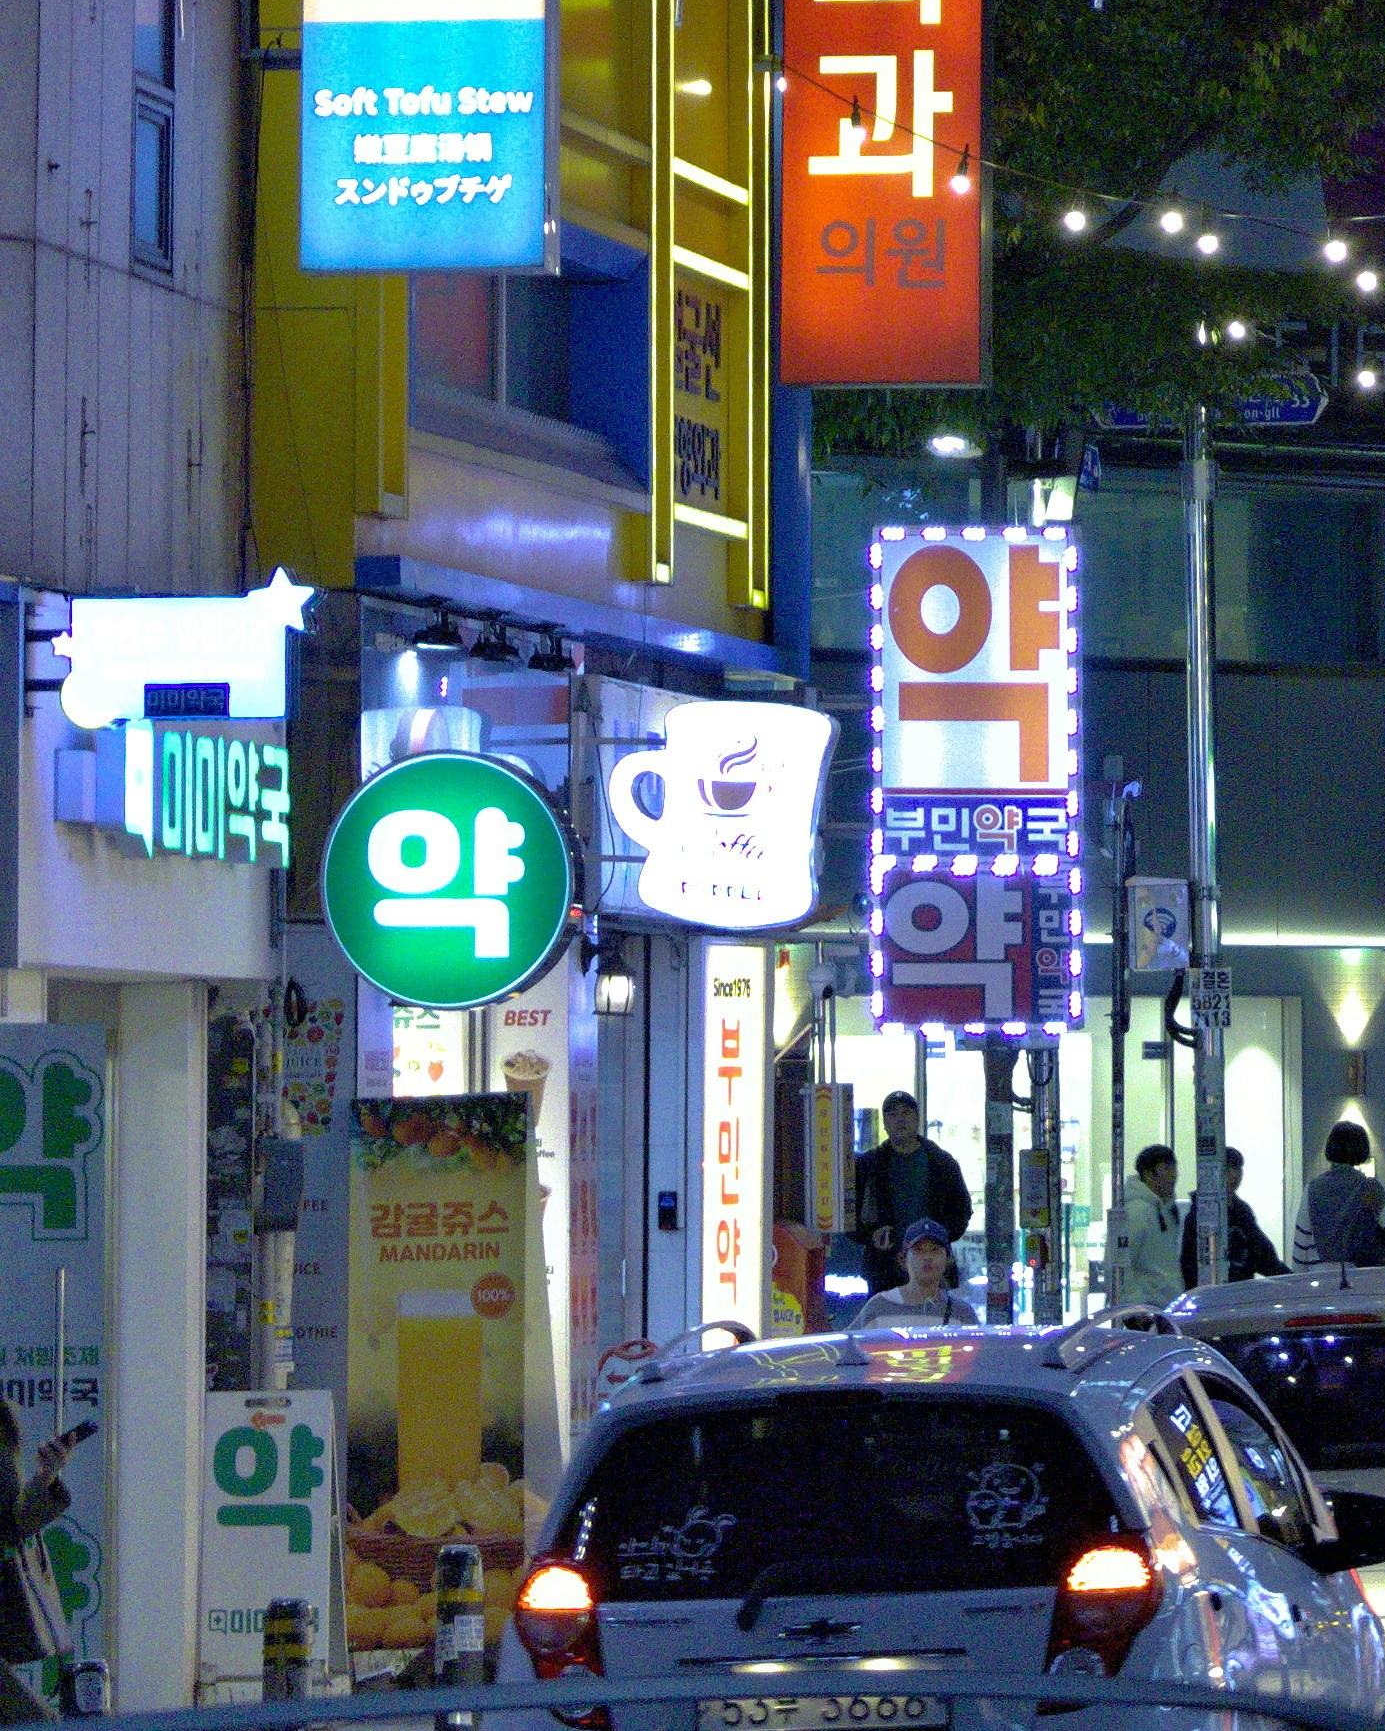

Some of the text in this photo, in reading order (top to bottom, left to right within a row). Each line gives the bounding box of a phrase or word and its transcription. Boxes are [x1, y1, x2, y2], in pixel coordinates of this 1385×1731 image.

[314, 84, 534, 116] Soft Tofu Stew
[817, 216, 947, 289] 의원
[888, 543, 1062, 784] 약
[162, 729, 291, 869] 미미약국
[883, 803, 1069, 853] 부민약국
[366, 805, 526, 959] 약
[885, 870, 1024, 1022] 약
[503, 1010, 551, 1027] BEST
[370, 1200, 510, 1240] 감귤쥬스
[379, 1241, 502, 1264] MANDARIN
[212, 1423, 325, 1555] 약
